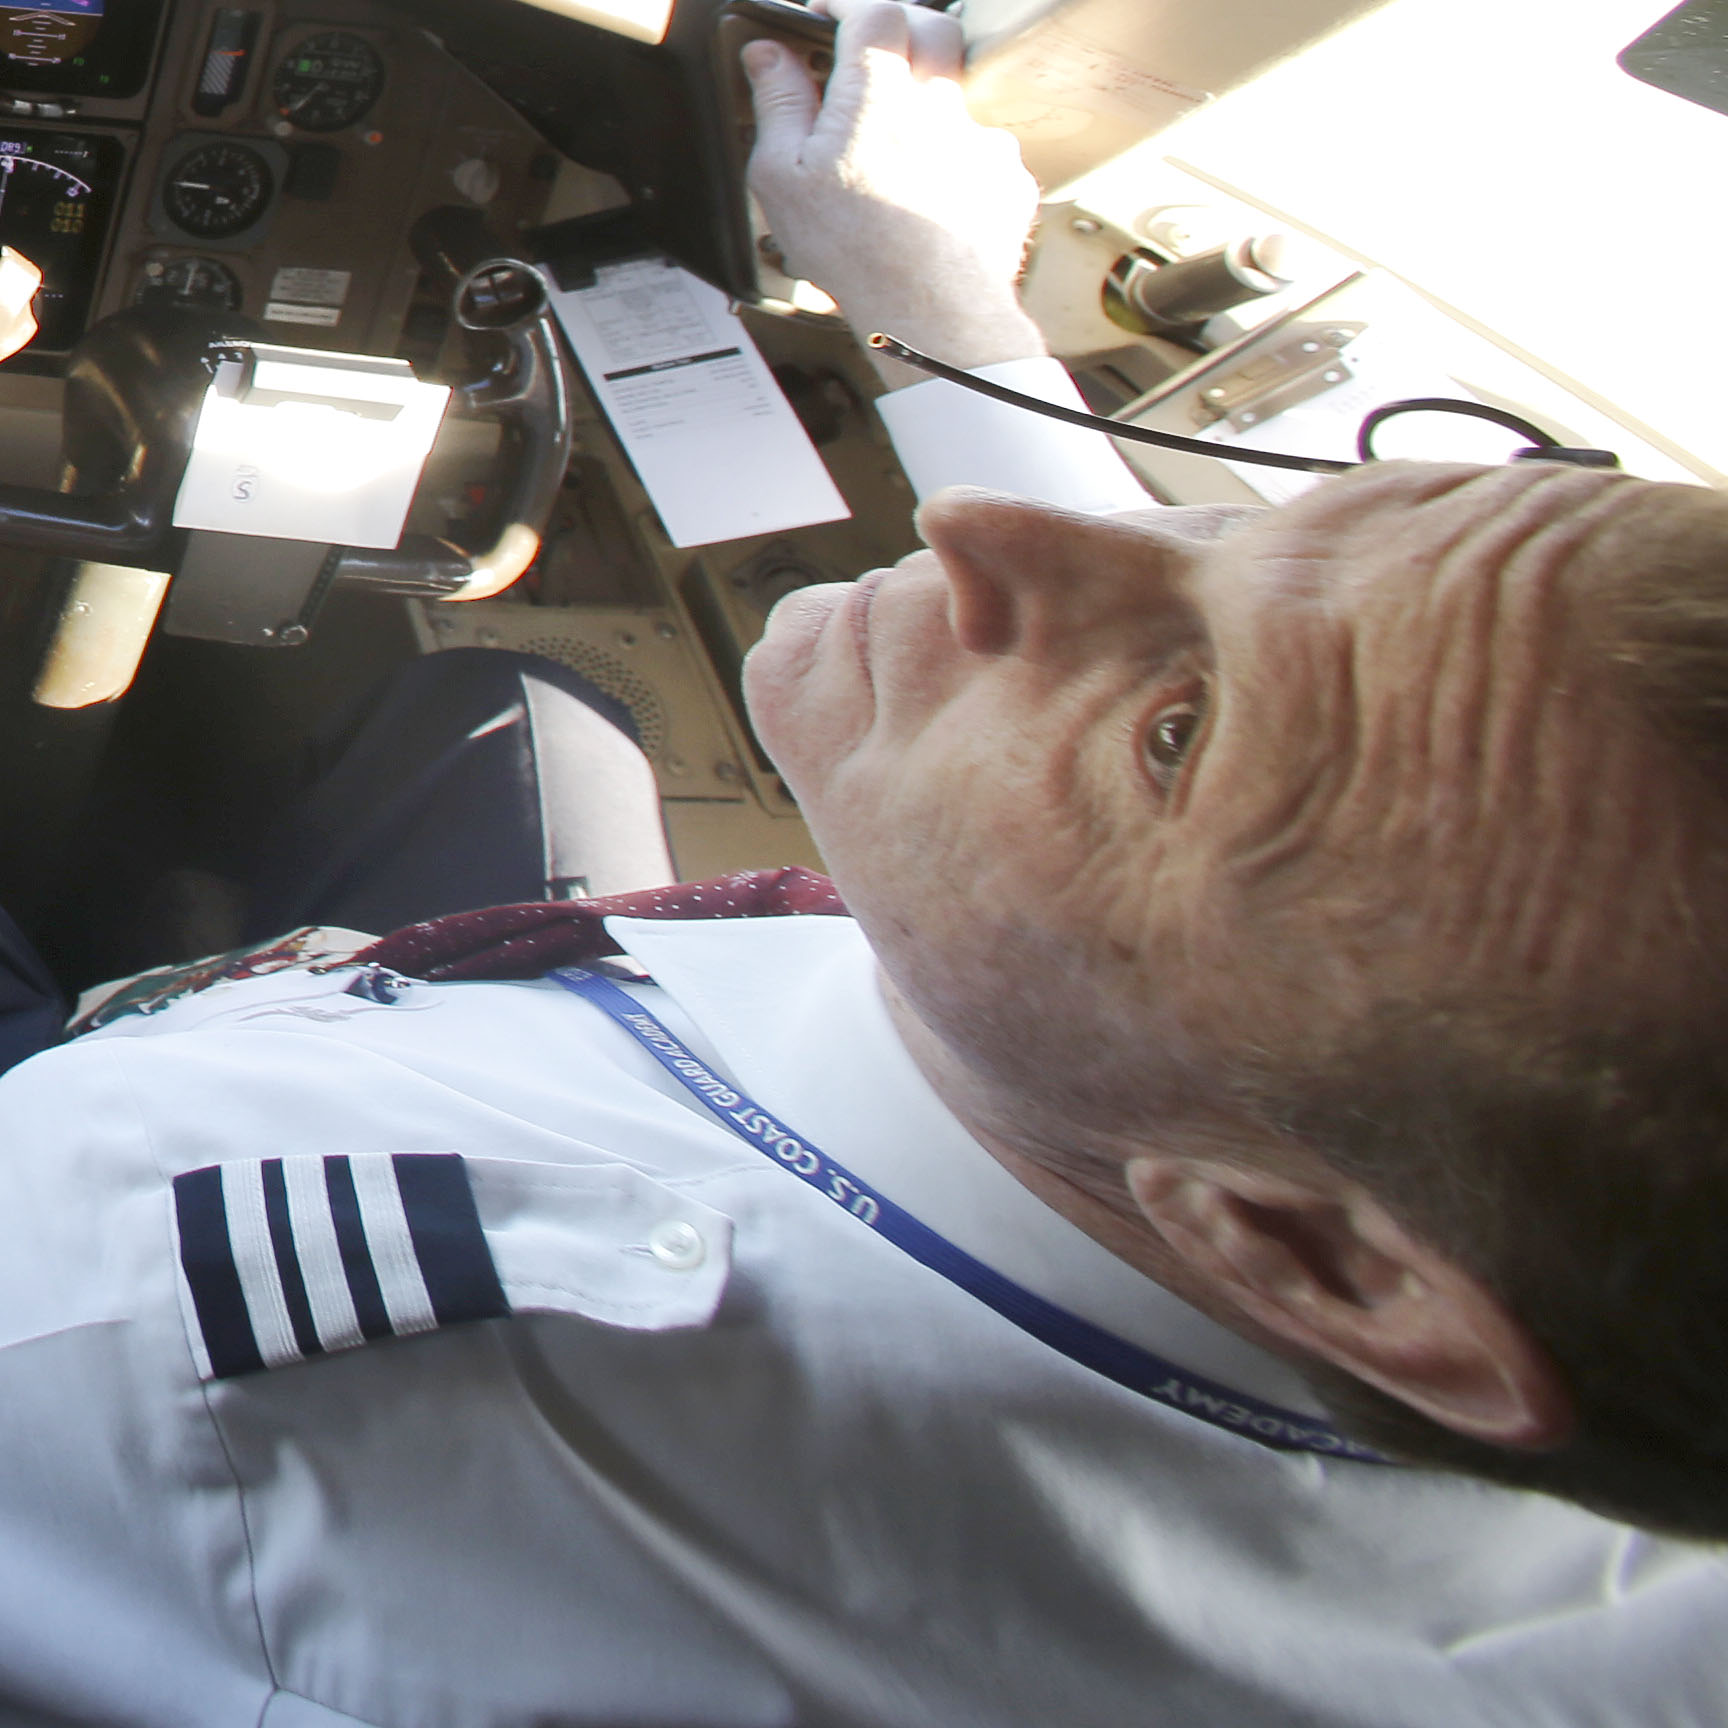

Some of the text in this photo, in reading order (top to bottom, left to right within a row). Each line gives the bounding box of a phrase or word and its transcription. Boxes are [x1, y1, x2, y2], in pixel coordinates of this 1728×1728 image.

[673, 1058, 740, 1108] GUARD
[729, 1107, 820, 1175] COAST
[826, 1168, 880, 1224] U.S.
